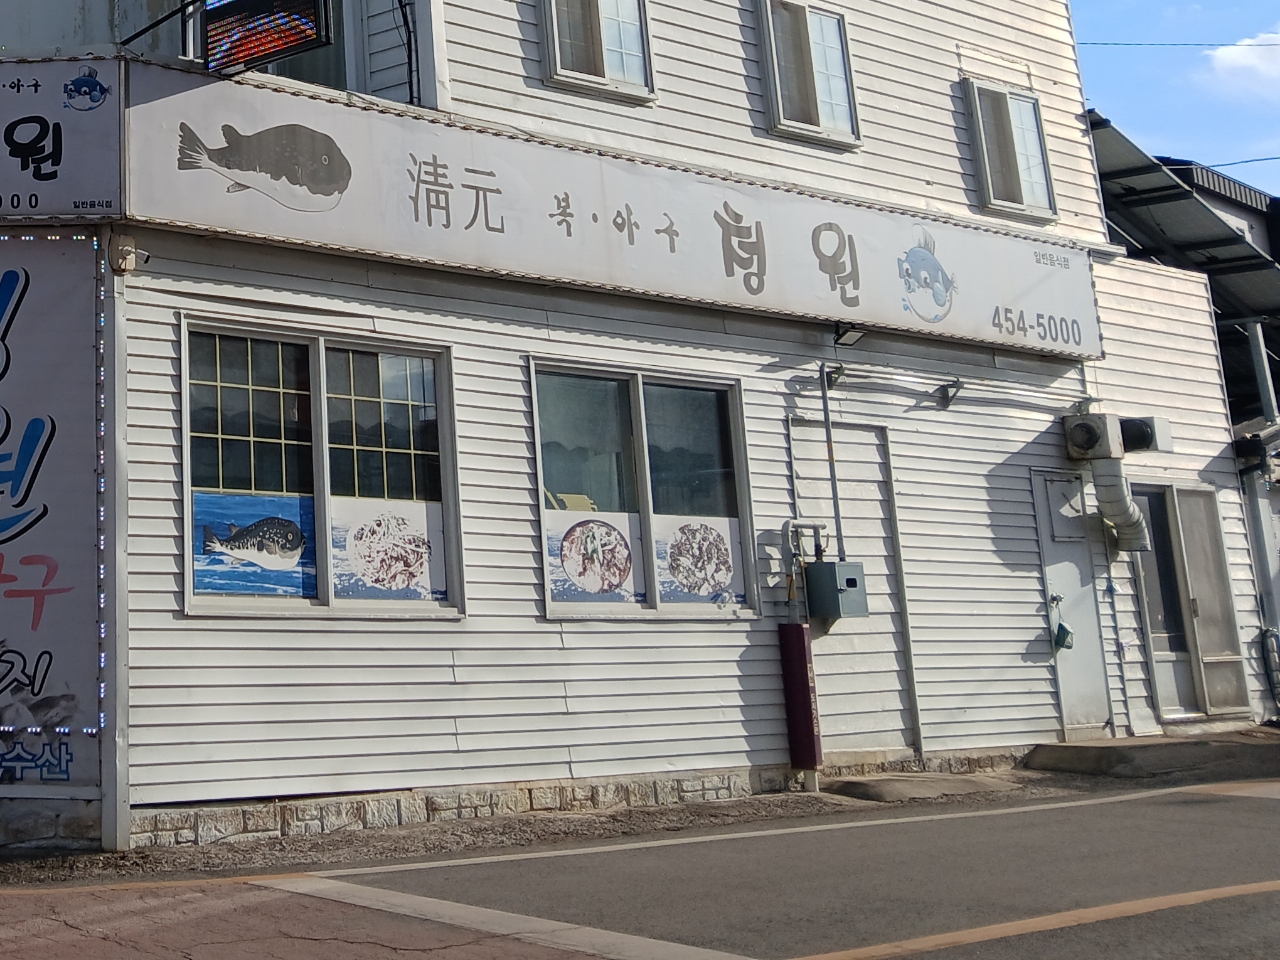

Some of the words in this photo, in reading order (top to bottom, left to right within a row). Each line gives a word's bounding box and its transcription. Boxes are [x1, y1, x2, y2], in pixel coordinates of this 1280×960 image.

[72, 200, 112, 209] 일반음식점
[1033, 250, 1070, 269] 일반음식점
[992, 306, 1082, 346] 454-5000
